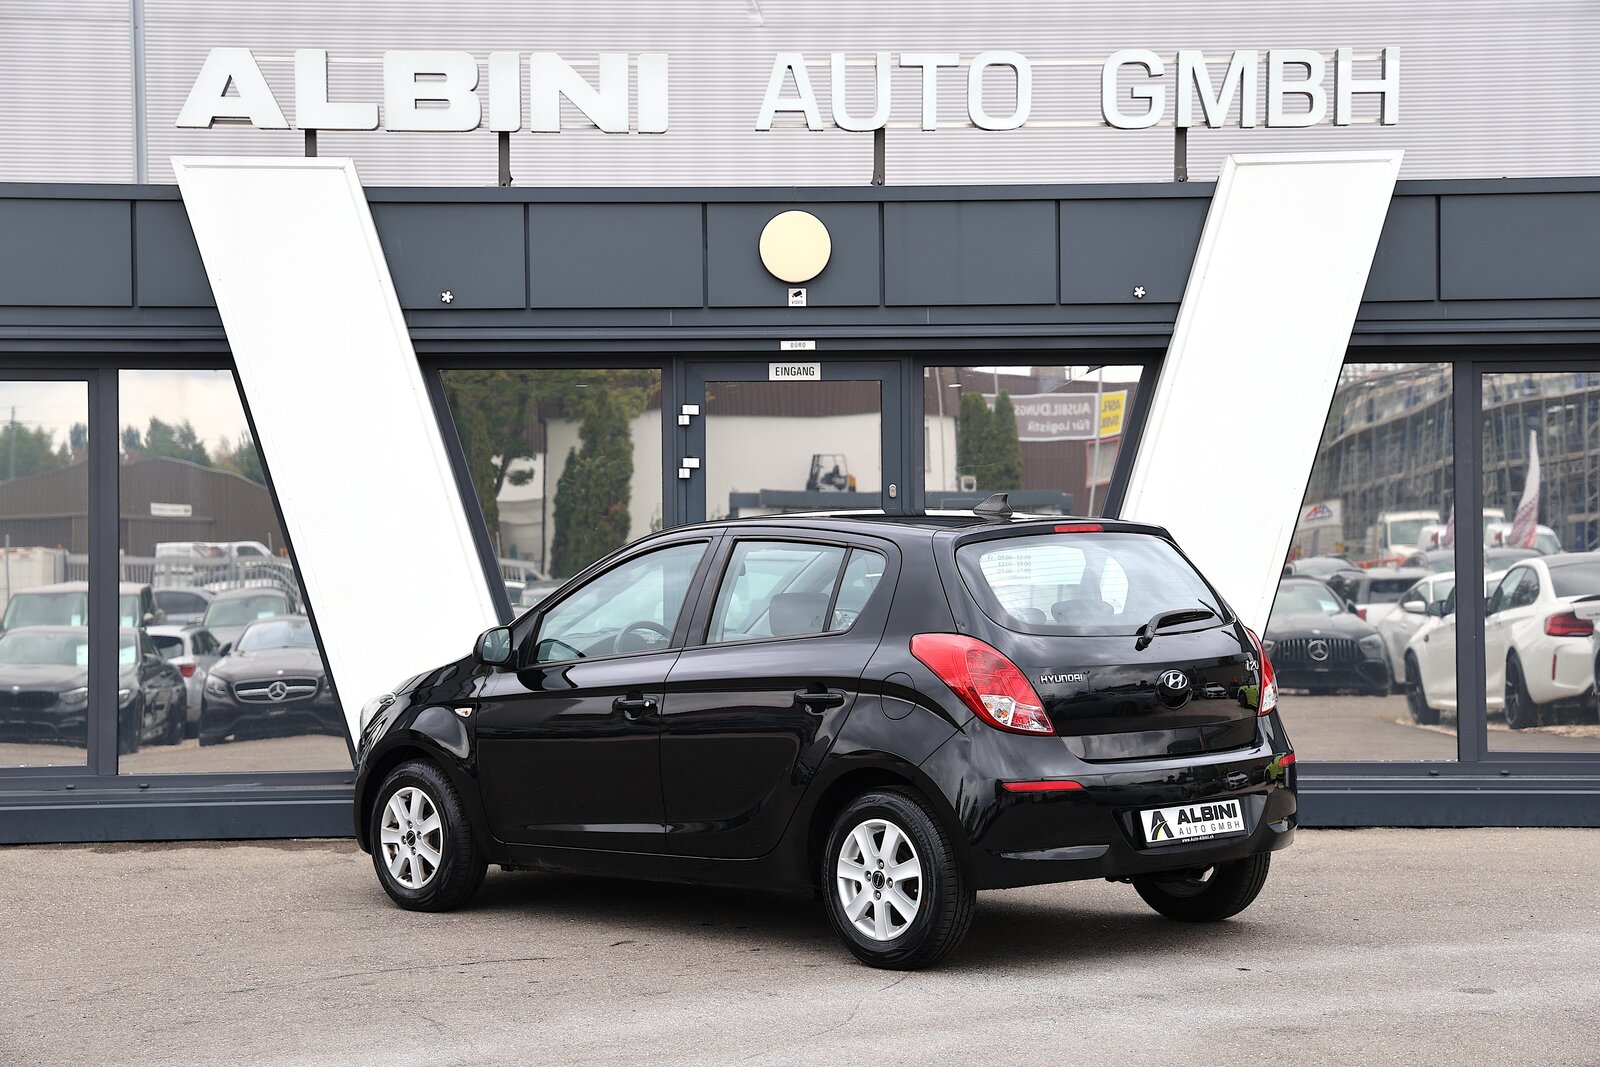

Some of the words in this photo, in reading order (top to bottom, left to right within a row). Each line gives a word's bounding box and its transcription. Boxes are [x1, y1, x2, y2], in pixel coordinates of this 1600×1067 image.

[175, 46, 669, 134] ALBINI
[755, 51, 1034, 132] AUTO
[1100, 46, 1401, 130] GMBH
[775, 366, 815, 377] EINGANG
[1040, 673, 1083, 684] HYUNDAI
[1177, 803, 1238, 825] ALBINI
[1179, 824, 1207, 836] AUTO
[1211, 821, 1240, 832] GMBH
